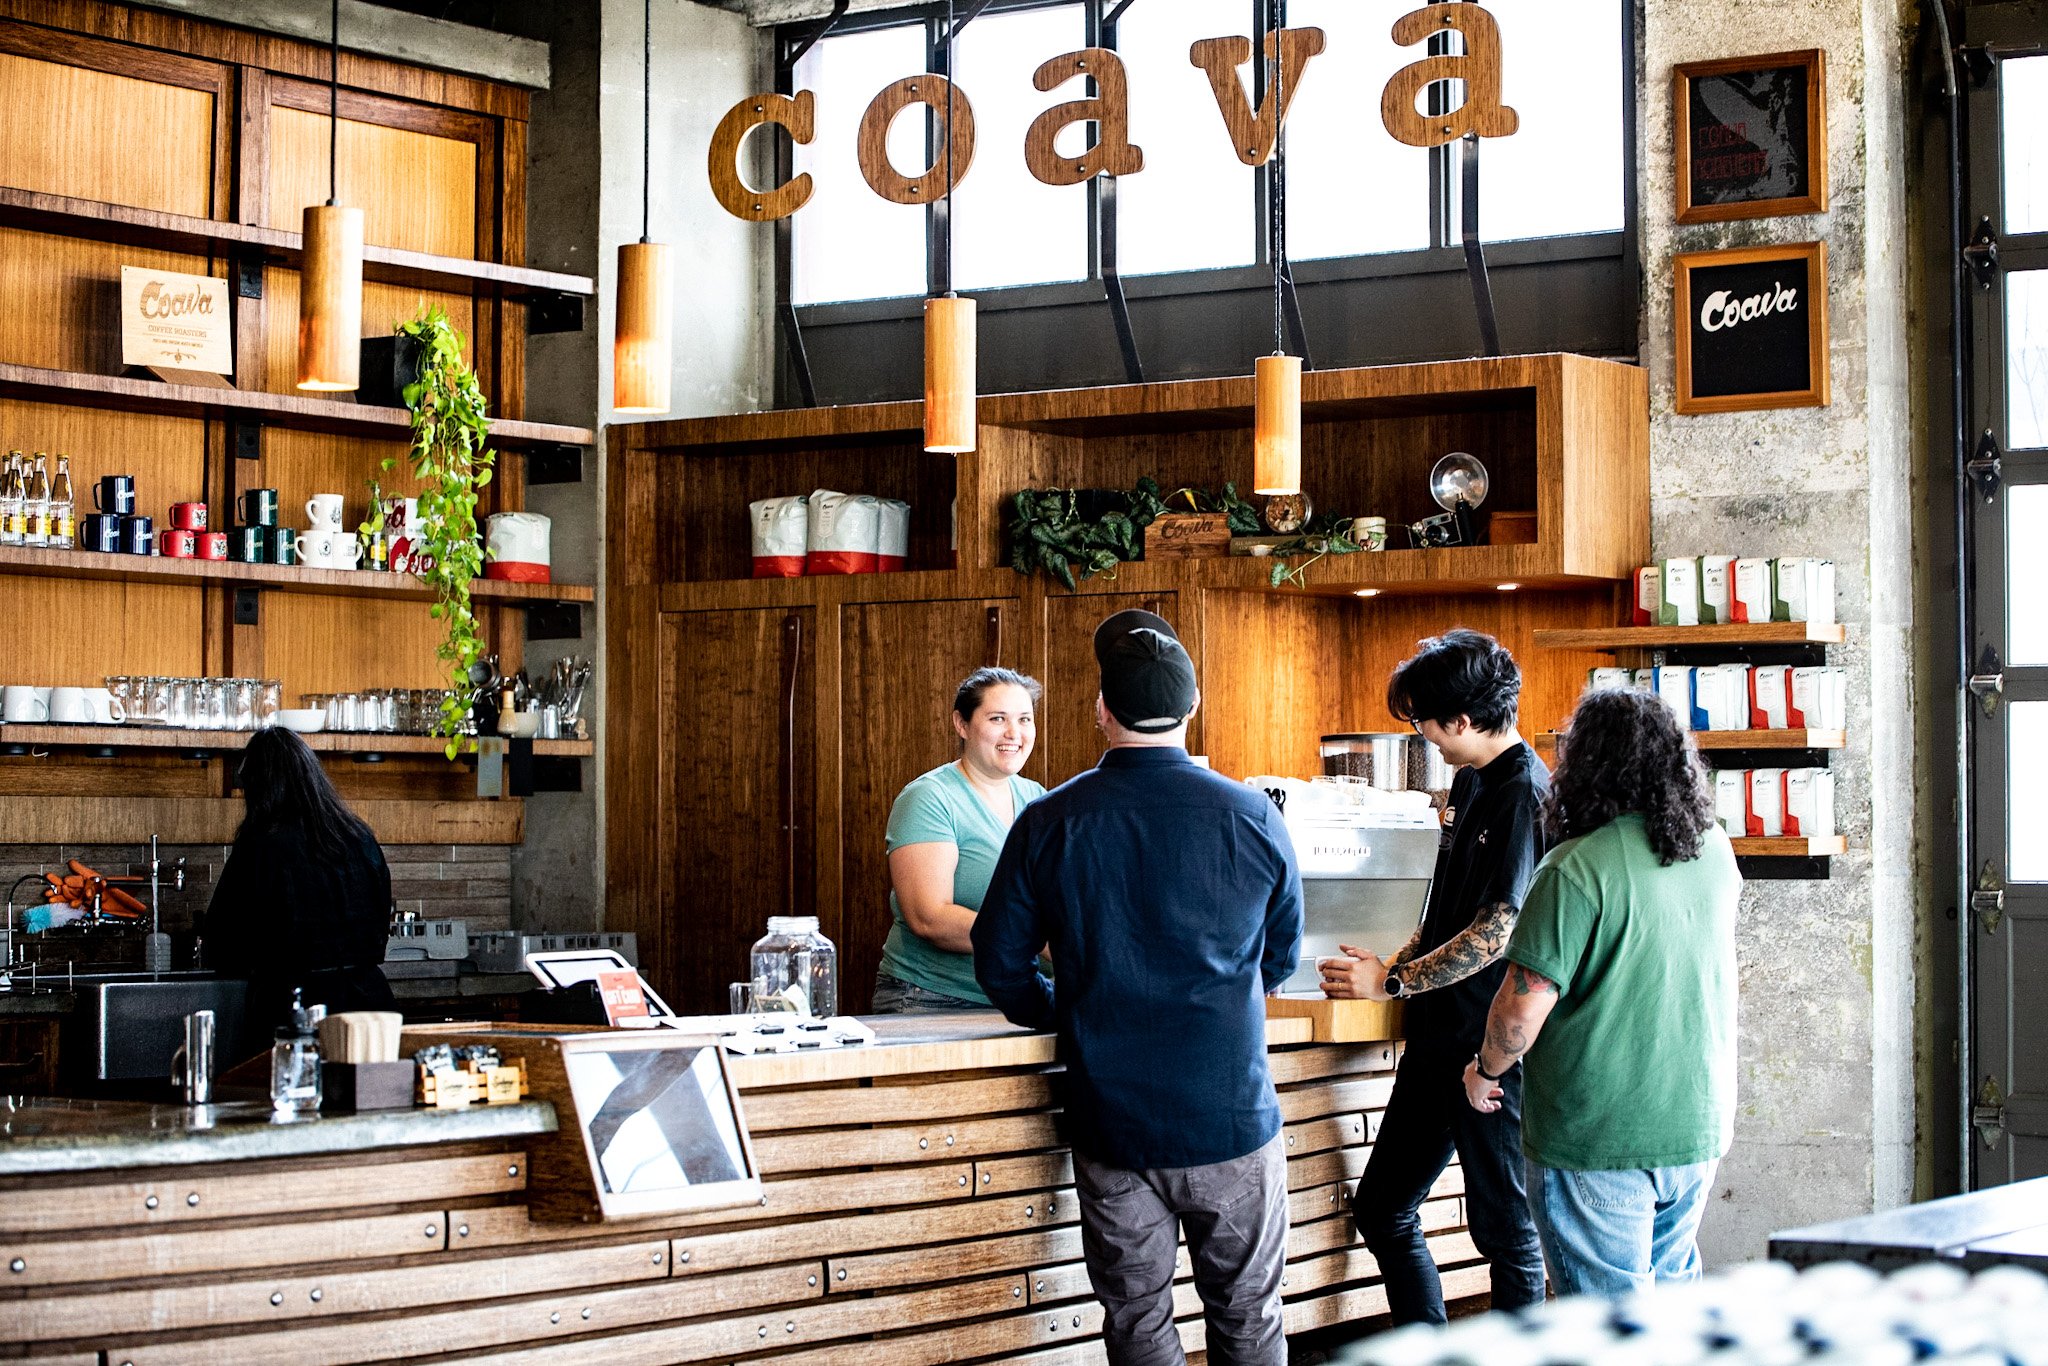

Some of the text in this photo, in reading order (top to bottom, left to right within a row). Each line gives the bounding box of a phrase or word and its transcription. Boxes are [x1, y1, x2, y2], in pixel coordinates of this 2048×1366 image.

[708, 3, 1519, 221] coava
[139, 280, 214, 320] Coava
[1700, 281, 1798, 332] Coava
[147, 324, 207, 338] COFFEE ROASTERS
[1161, 516, 1214, 540] Coava
[388, 536, 438, 573] Coa
